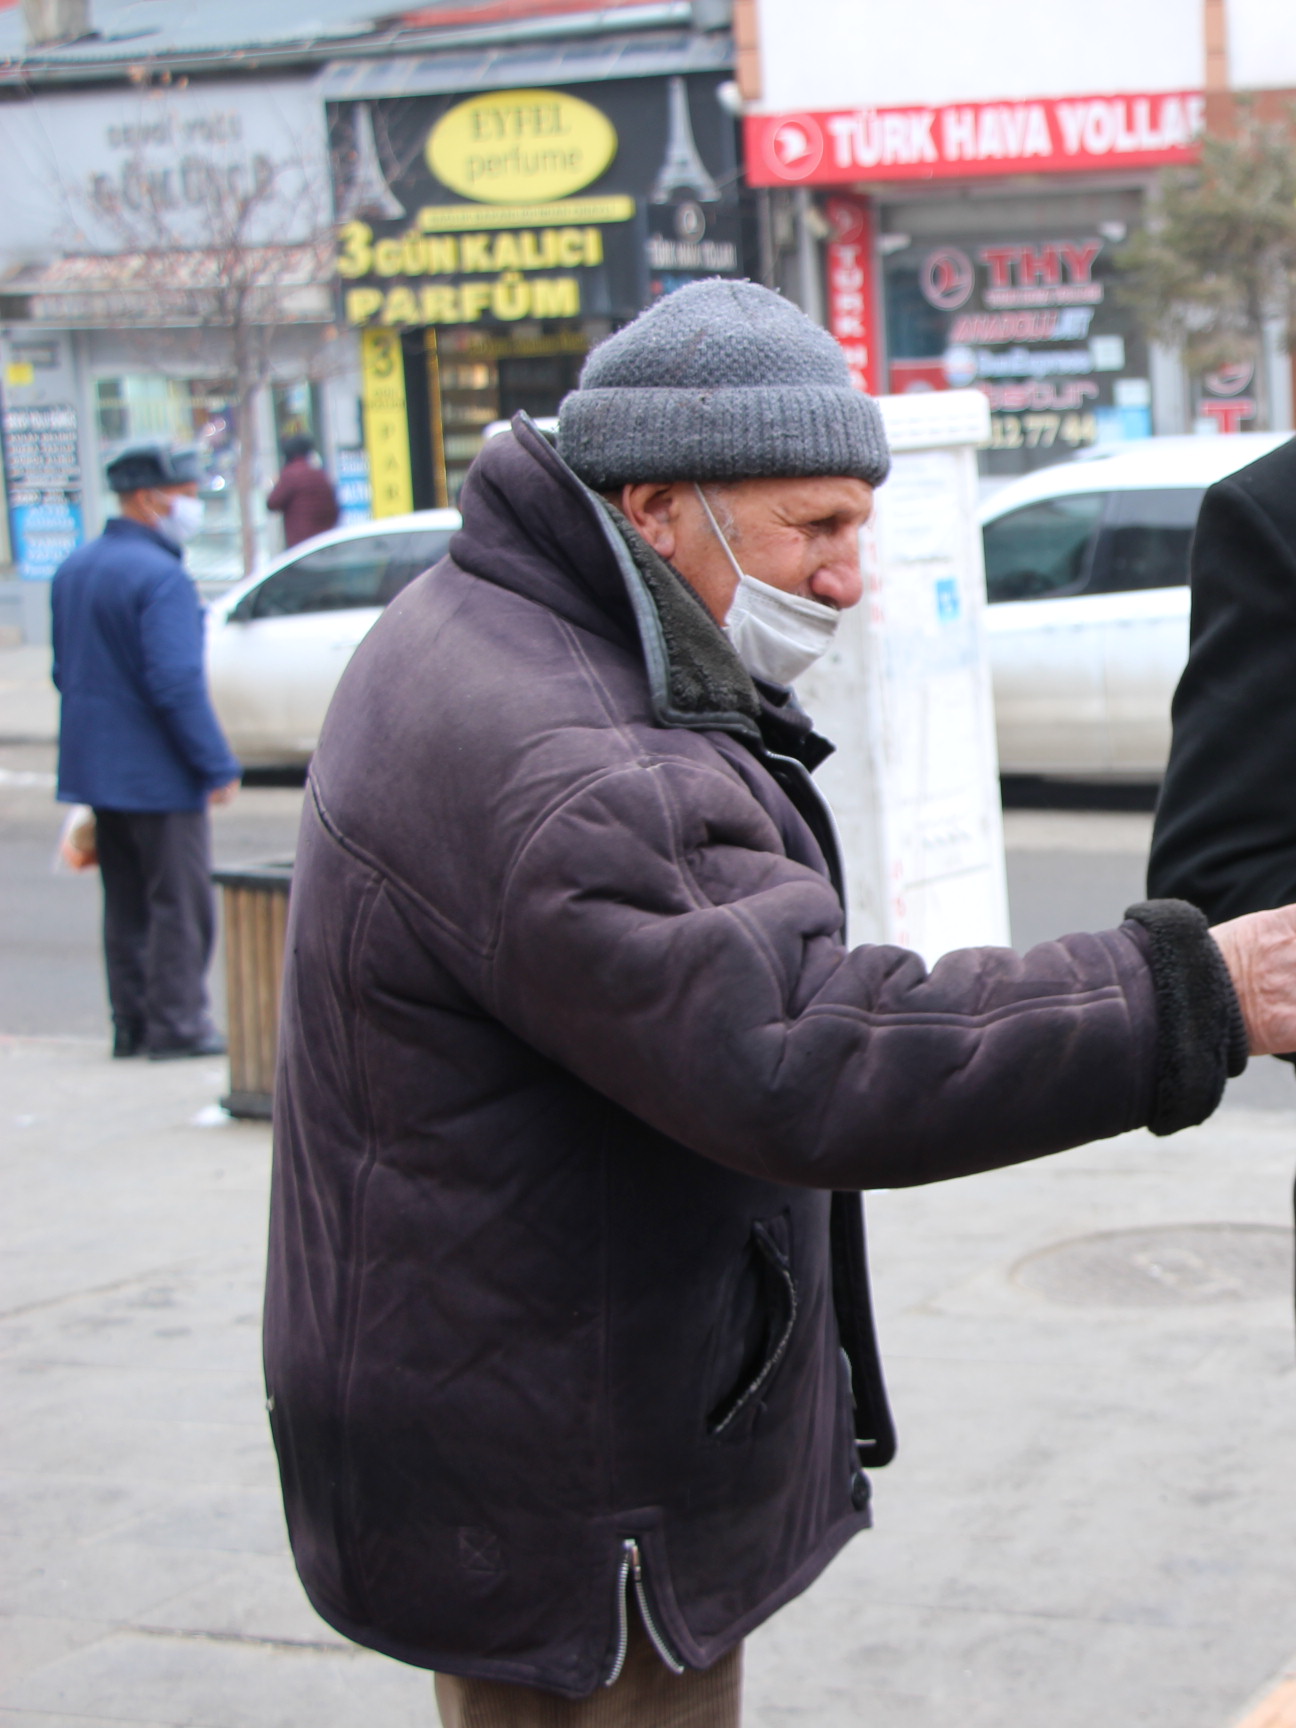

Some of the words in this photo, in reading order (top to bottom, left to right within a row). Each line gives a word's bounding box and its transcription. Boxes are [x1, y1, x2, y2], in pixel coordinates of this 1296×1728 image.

[471, 102, 570, 142] EYFEL
[828, 107, 937, 169] TÜRK
[941, 102, 1053, 162] HAVA
[466, 146, 584, 183] perfume
[336, 220, 374, 279] 3
[373, 229, 458, 278] GÜN
[459, 227, 603, 274] KALICI
[980, 240, 1102, 289] THY
[345, 270, 581, 327] PARFÜM
